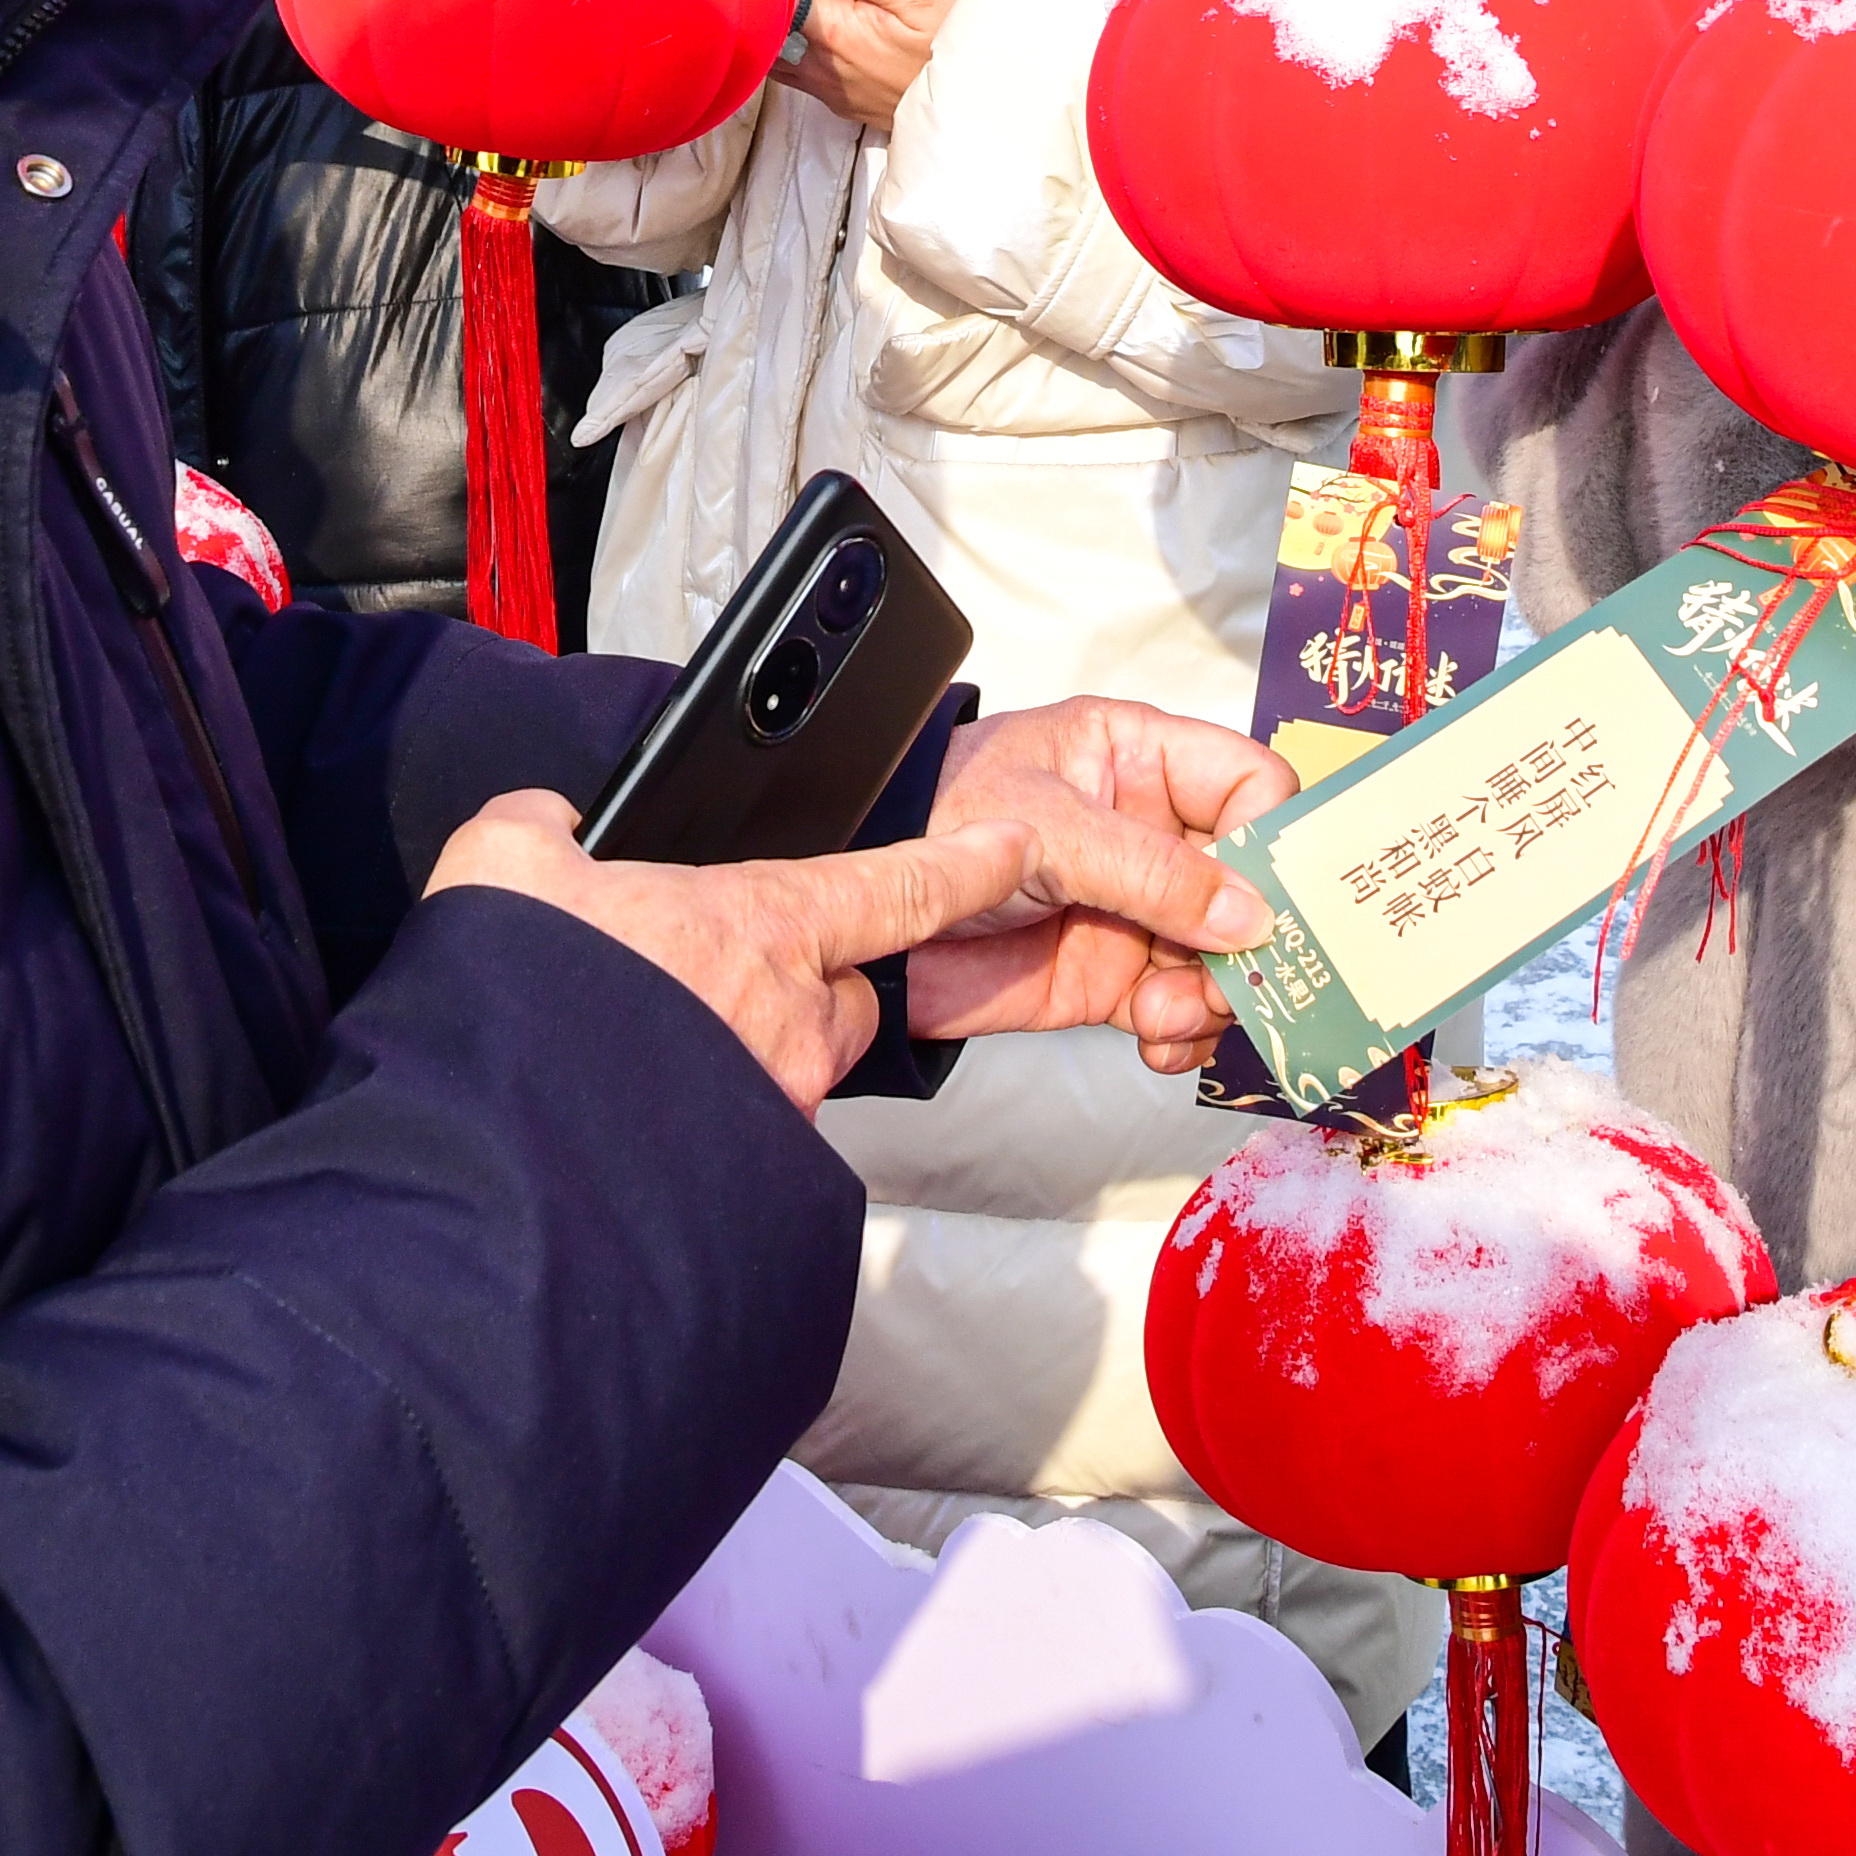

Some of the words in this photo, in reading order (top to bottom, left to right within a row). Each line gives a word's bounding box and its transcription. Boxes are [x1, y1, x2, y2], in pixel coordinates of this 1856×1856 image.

[95, 477, 143, 551] CASUAL
[1339, 717, 1598, 905] 中间睡个黑和尚
[1265, 934, 1317, 1011] 一水果】
[1274, 908, 1332, 989] WQ-213
